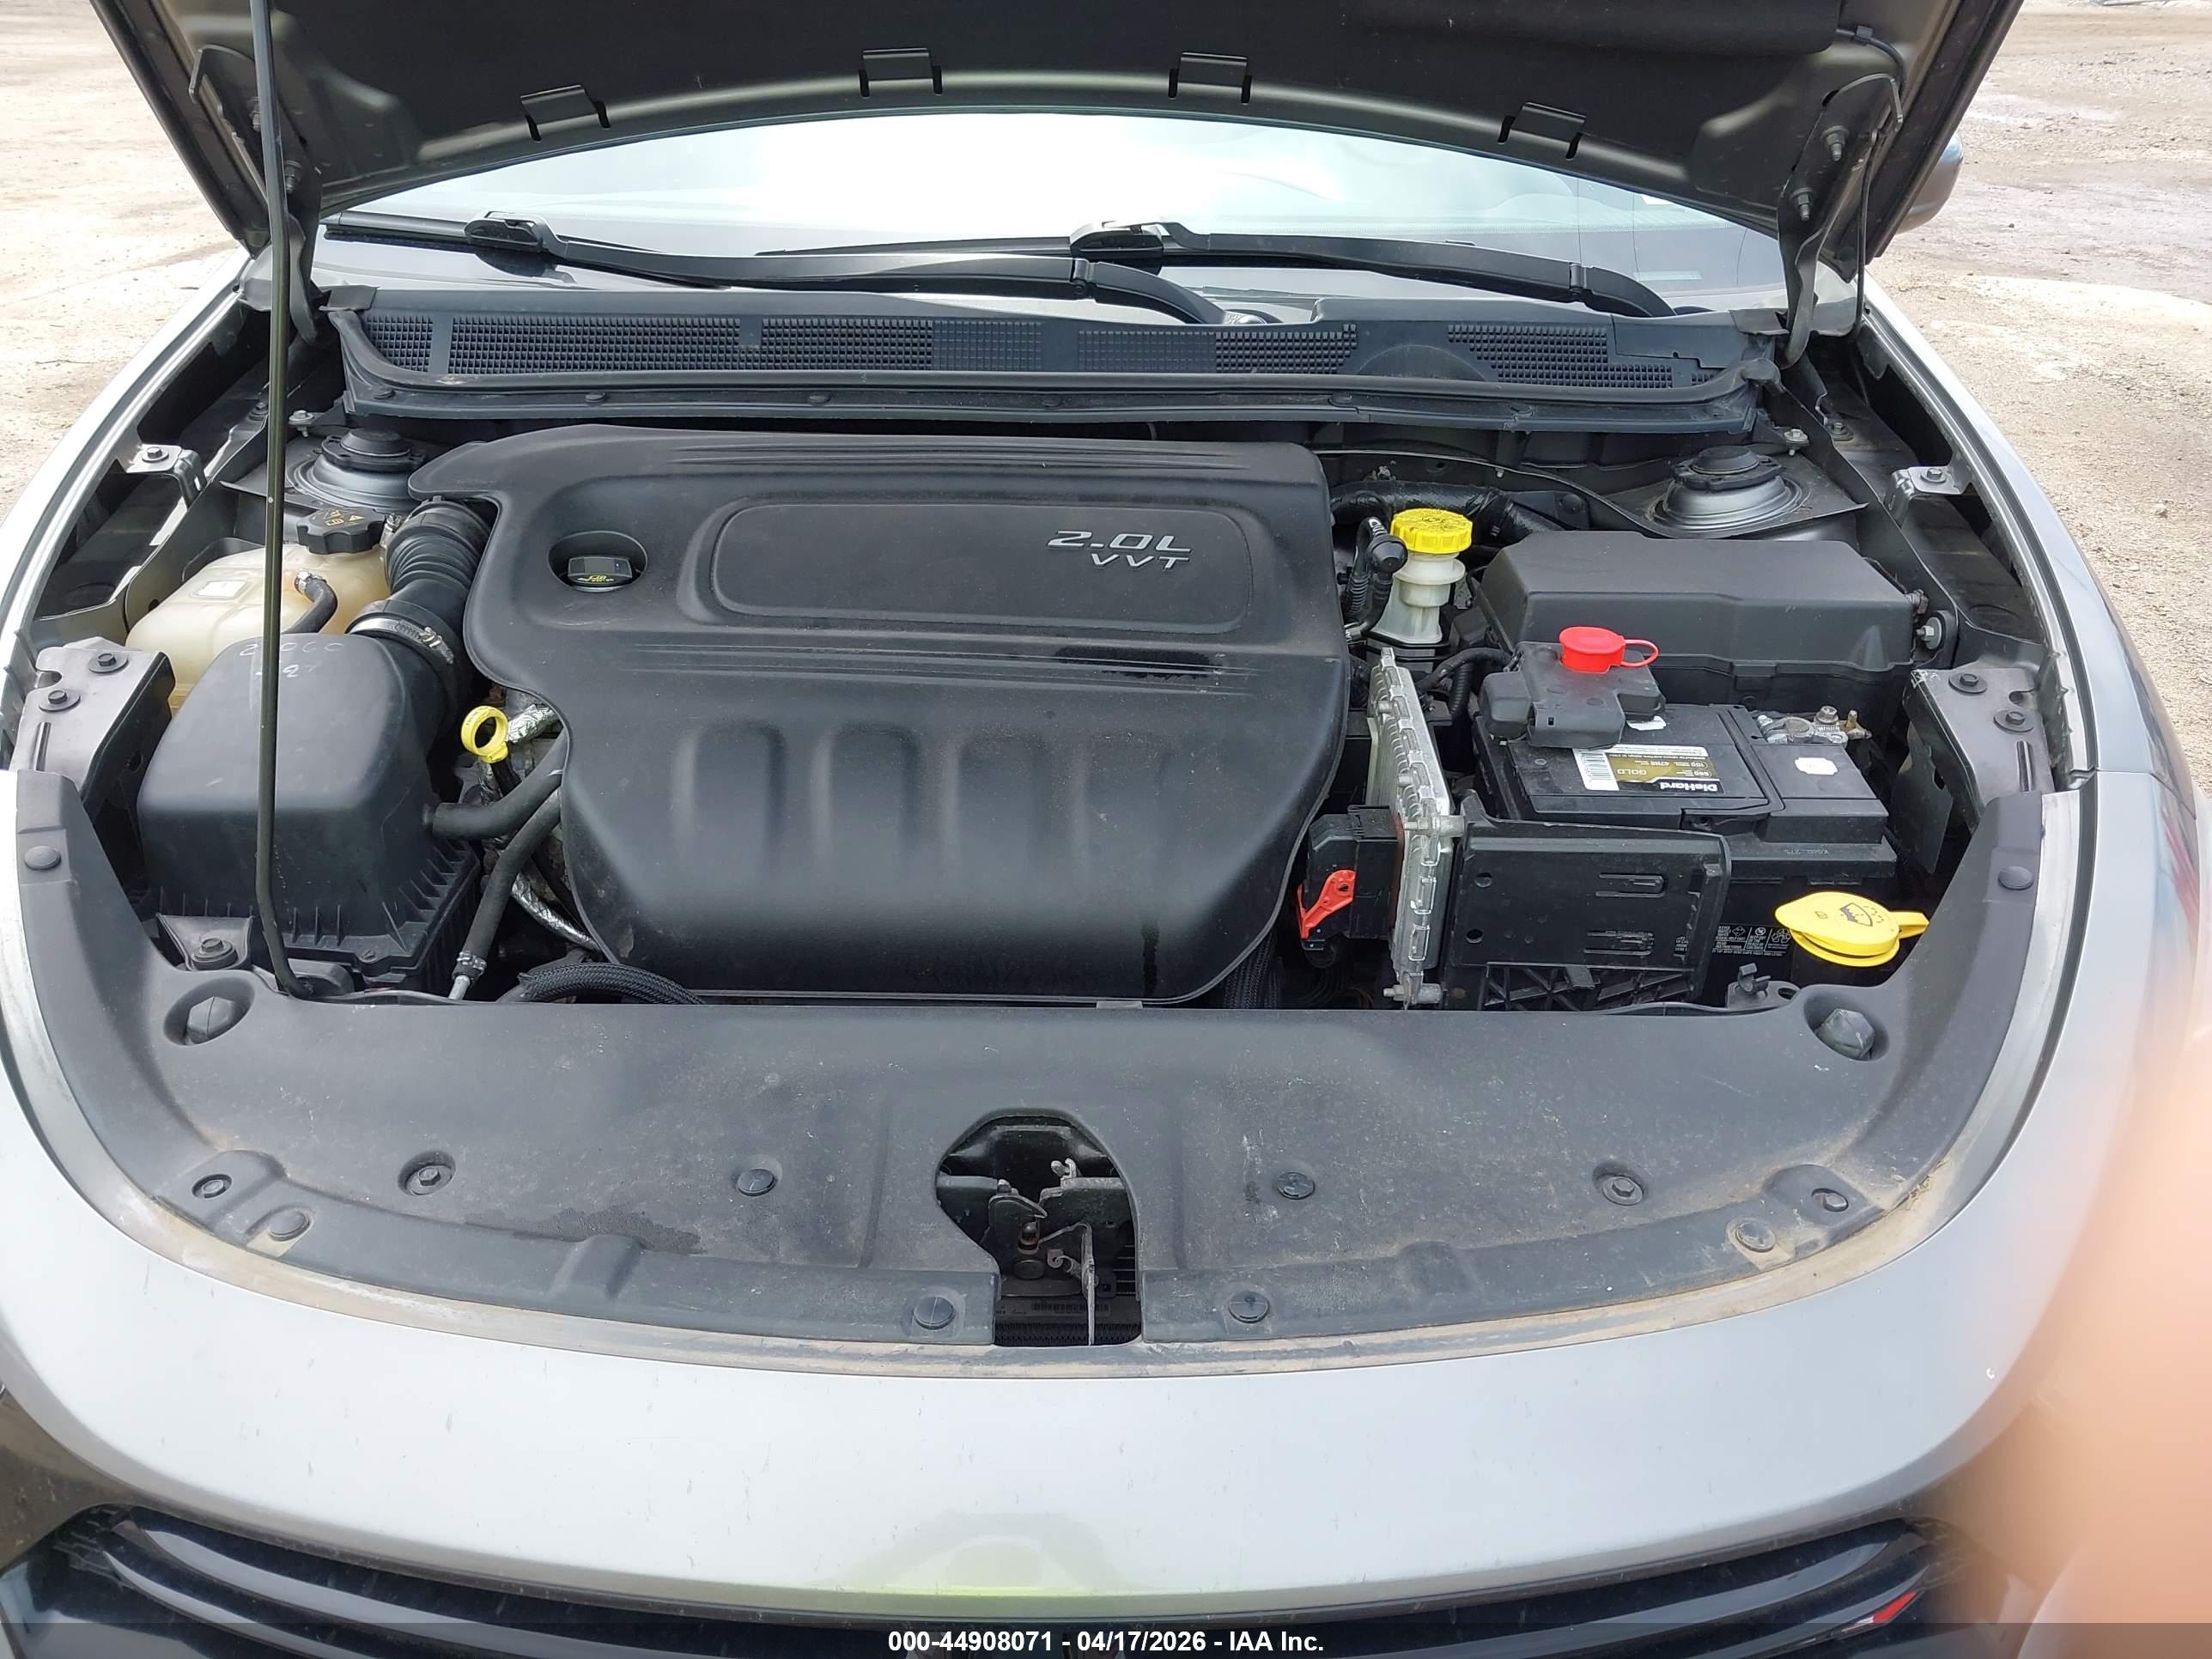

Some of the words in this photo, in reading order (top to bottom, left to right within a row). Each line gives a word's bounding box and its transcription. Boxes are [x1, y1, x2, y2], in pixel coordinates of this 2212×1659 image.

[1048, 530, 1192, 552] 2.0L
[1091, 553, 1189, 569] VVT
[1661, 782, 1718, 793] DieHard
